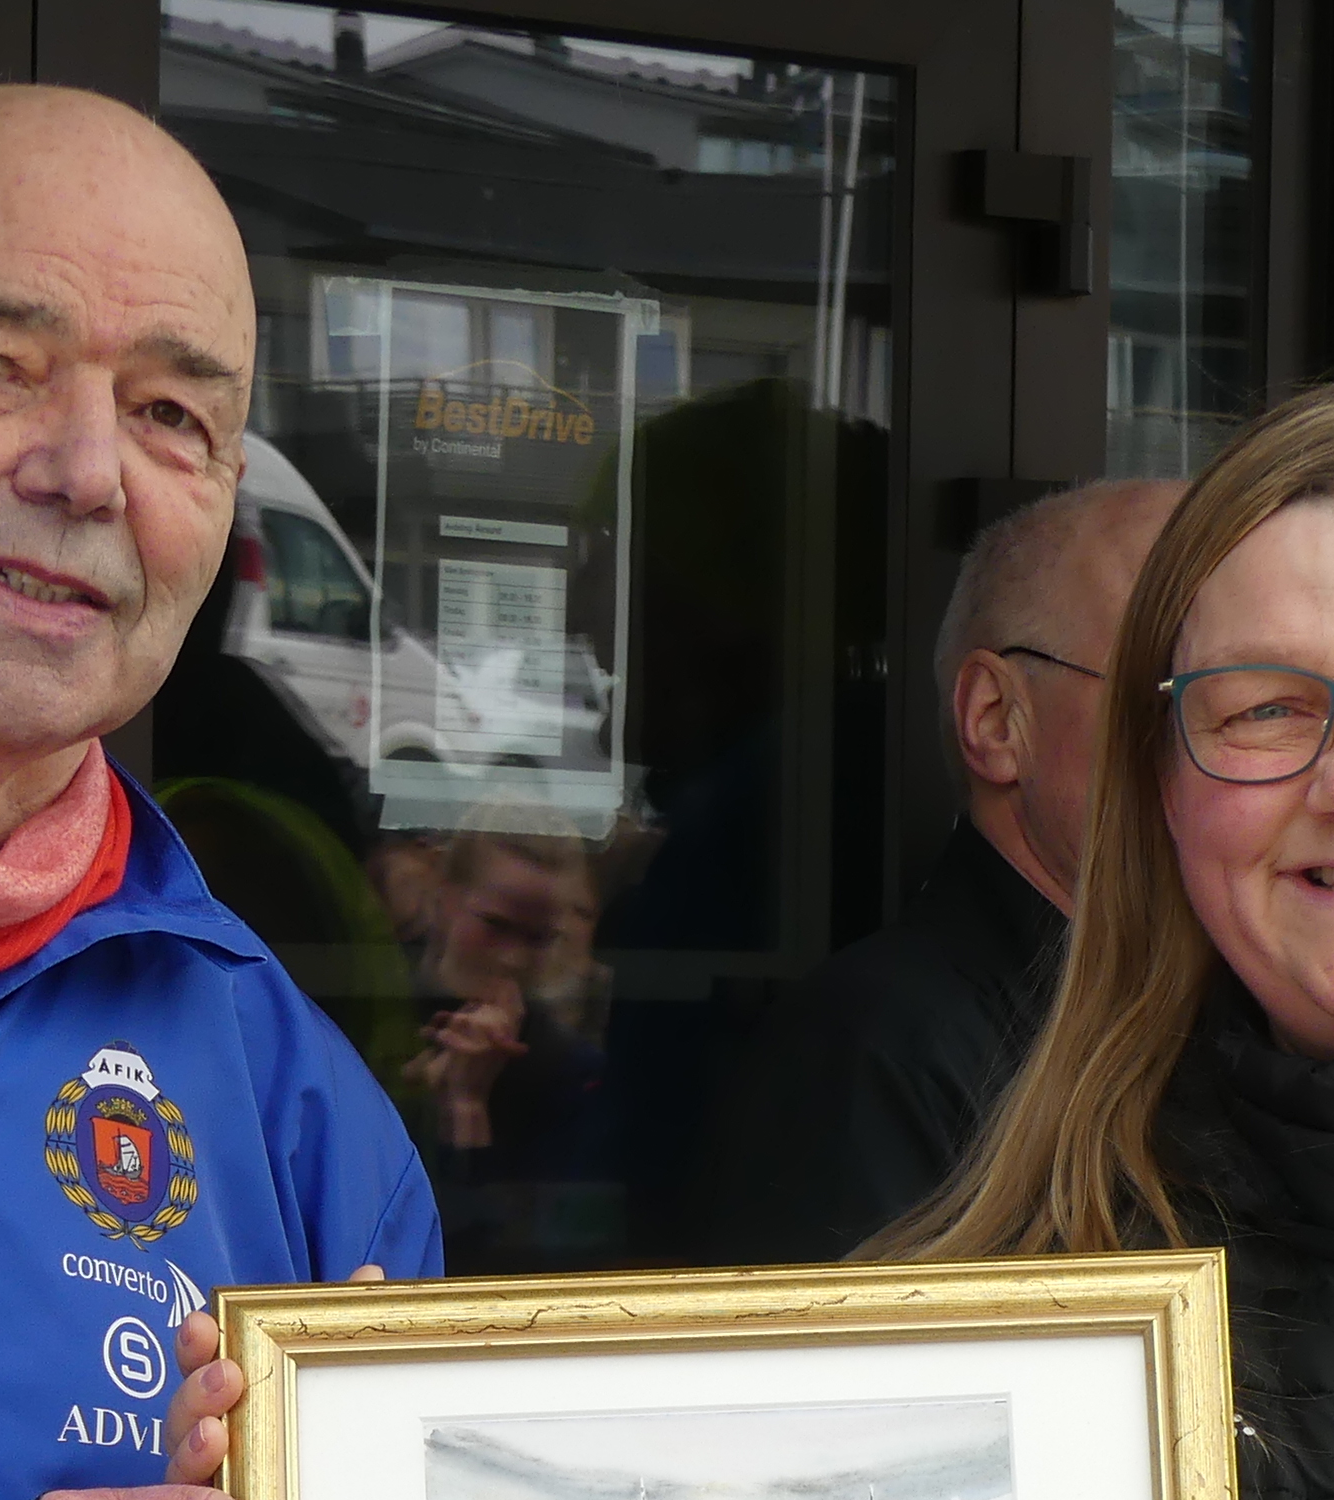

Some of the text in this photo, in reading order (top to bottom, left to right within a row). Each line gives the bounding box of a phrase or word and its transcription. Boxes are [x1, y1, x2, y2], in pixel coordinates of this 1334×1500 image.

[415, 390, 595, 445] BestDrive
[413, 436, 502, 459] by Continental
[97, 1056, 146, 1085] ÅFIK
[62, 1252, 168, 1304] converto
